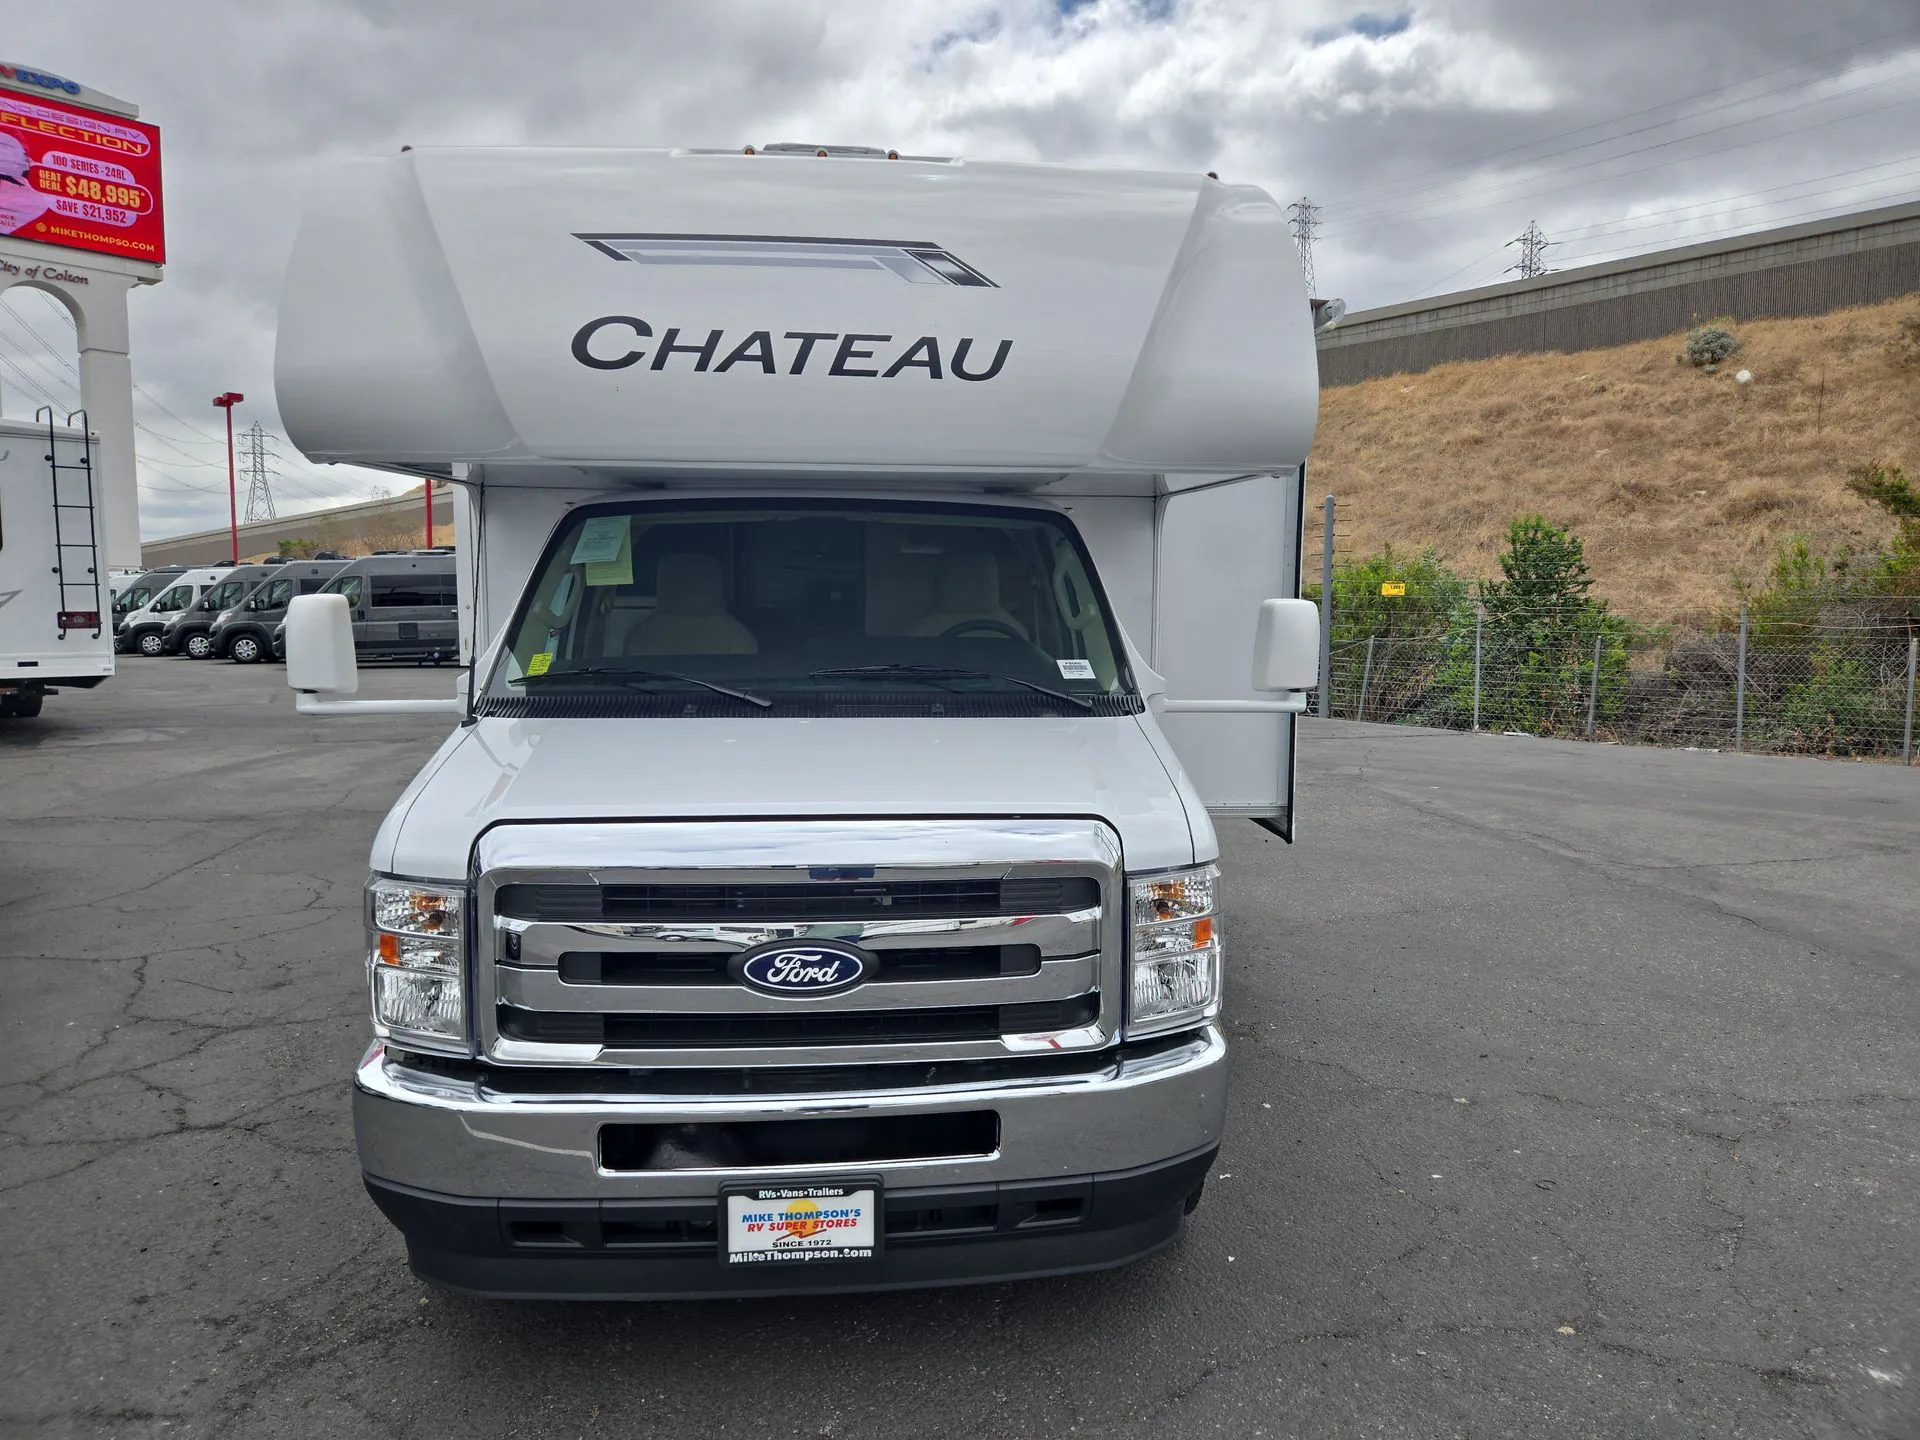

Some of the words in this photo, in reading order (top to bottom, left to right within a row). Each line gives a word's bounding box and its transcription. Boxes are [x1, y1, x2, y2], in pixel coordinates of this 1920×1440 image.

[0, 111, 142, 154] FLECTION
[36, 109, 110, 133] DESIGN
[115, 126, 141, 139] RV
[52, 155, 67, 167] 100
[40, 179, 62, 192] DEAL
[56, 199, 79, 213] SAVE
[83, 203, 127, 223] $21,952
[51, 226, 155, 252] MIKETHOMPSO.COM
[25, 265, 41, 278] of
[43, 267, 89, 285] Colton
[570, 315, 1013, 382] CHATEAU
[767, 954, 840, 983] Ford
[742, 1213, 774, 1223] MIKE
[778, 1209, 861, 1221] THOMPSON'S
[747, 1223, 764, 1232] RV
[769, 1220, 807, 1232] SUPER
[812, 1218, 857, 1229] STORES
[772, 1241, 804, 1249] SINCE
[808, 1239, 832, 1247] 1972
[729, 1249, 872, 1263] MikeThompson.com
